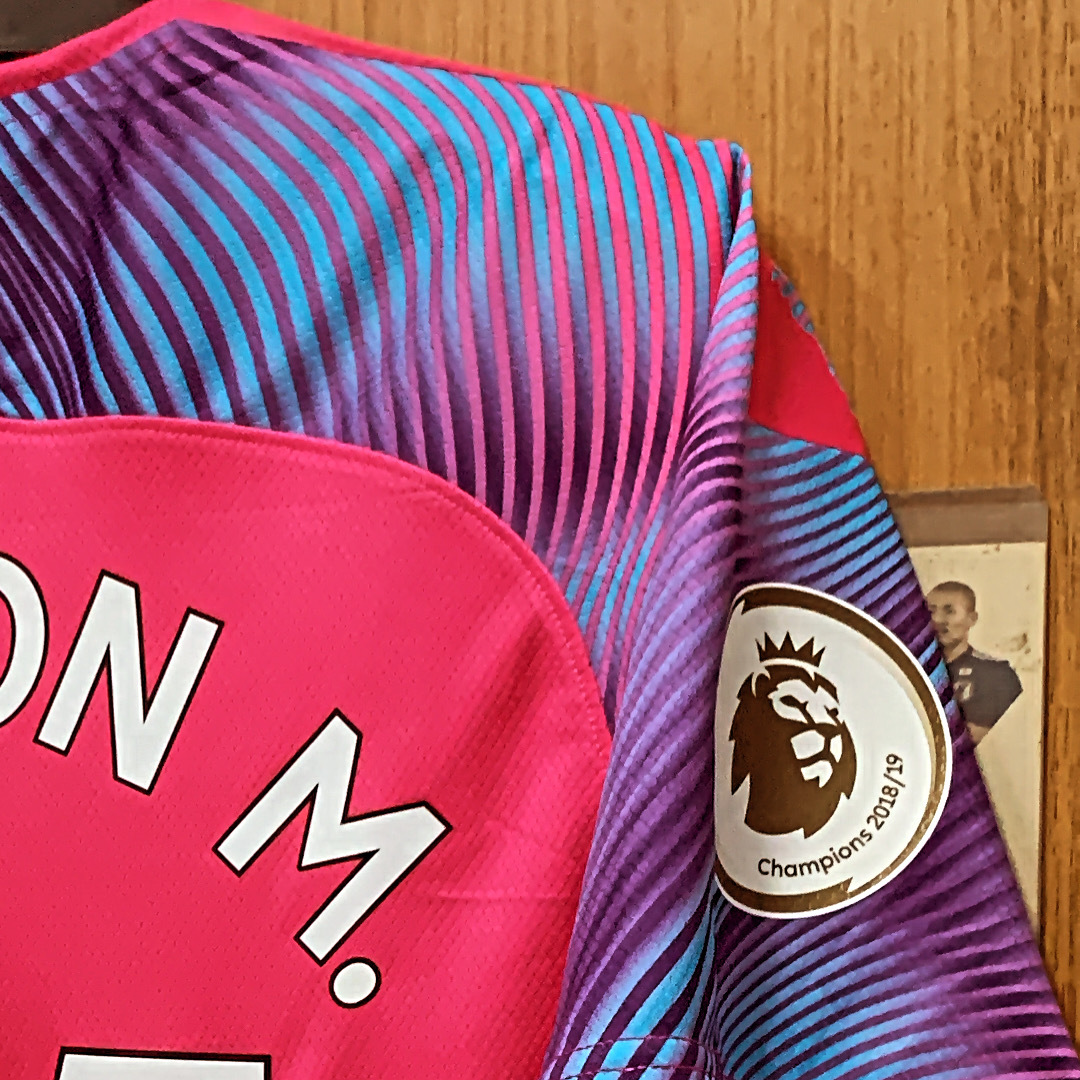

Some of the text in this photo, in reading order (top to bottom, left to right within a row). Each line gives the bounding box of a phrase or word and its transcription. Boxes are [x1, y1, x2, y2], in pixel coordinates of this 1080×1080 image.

[212, 708, 453, 1009] M.
[757, 753, 906, 877] Champions 2018/19
